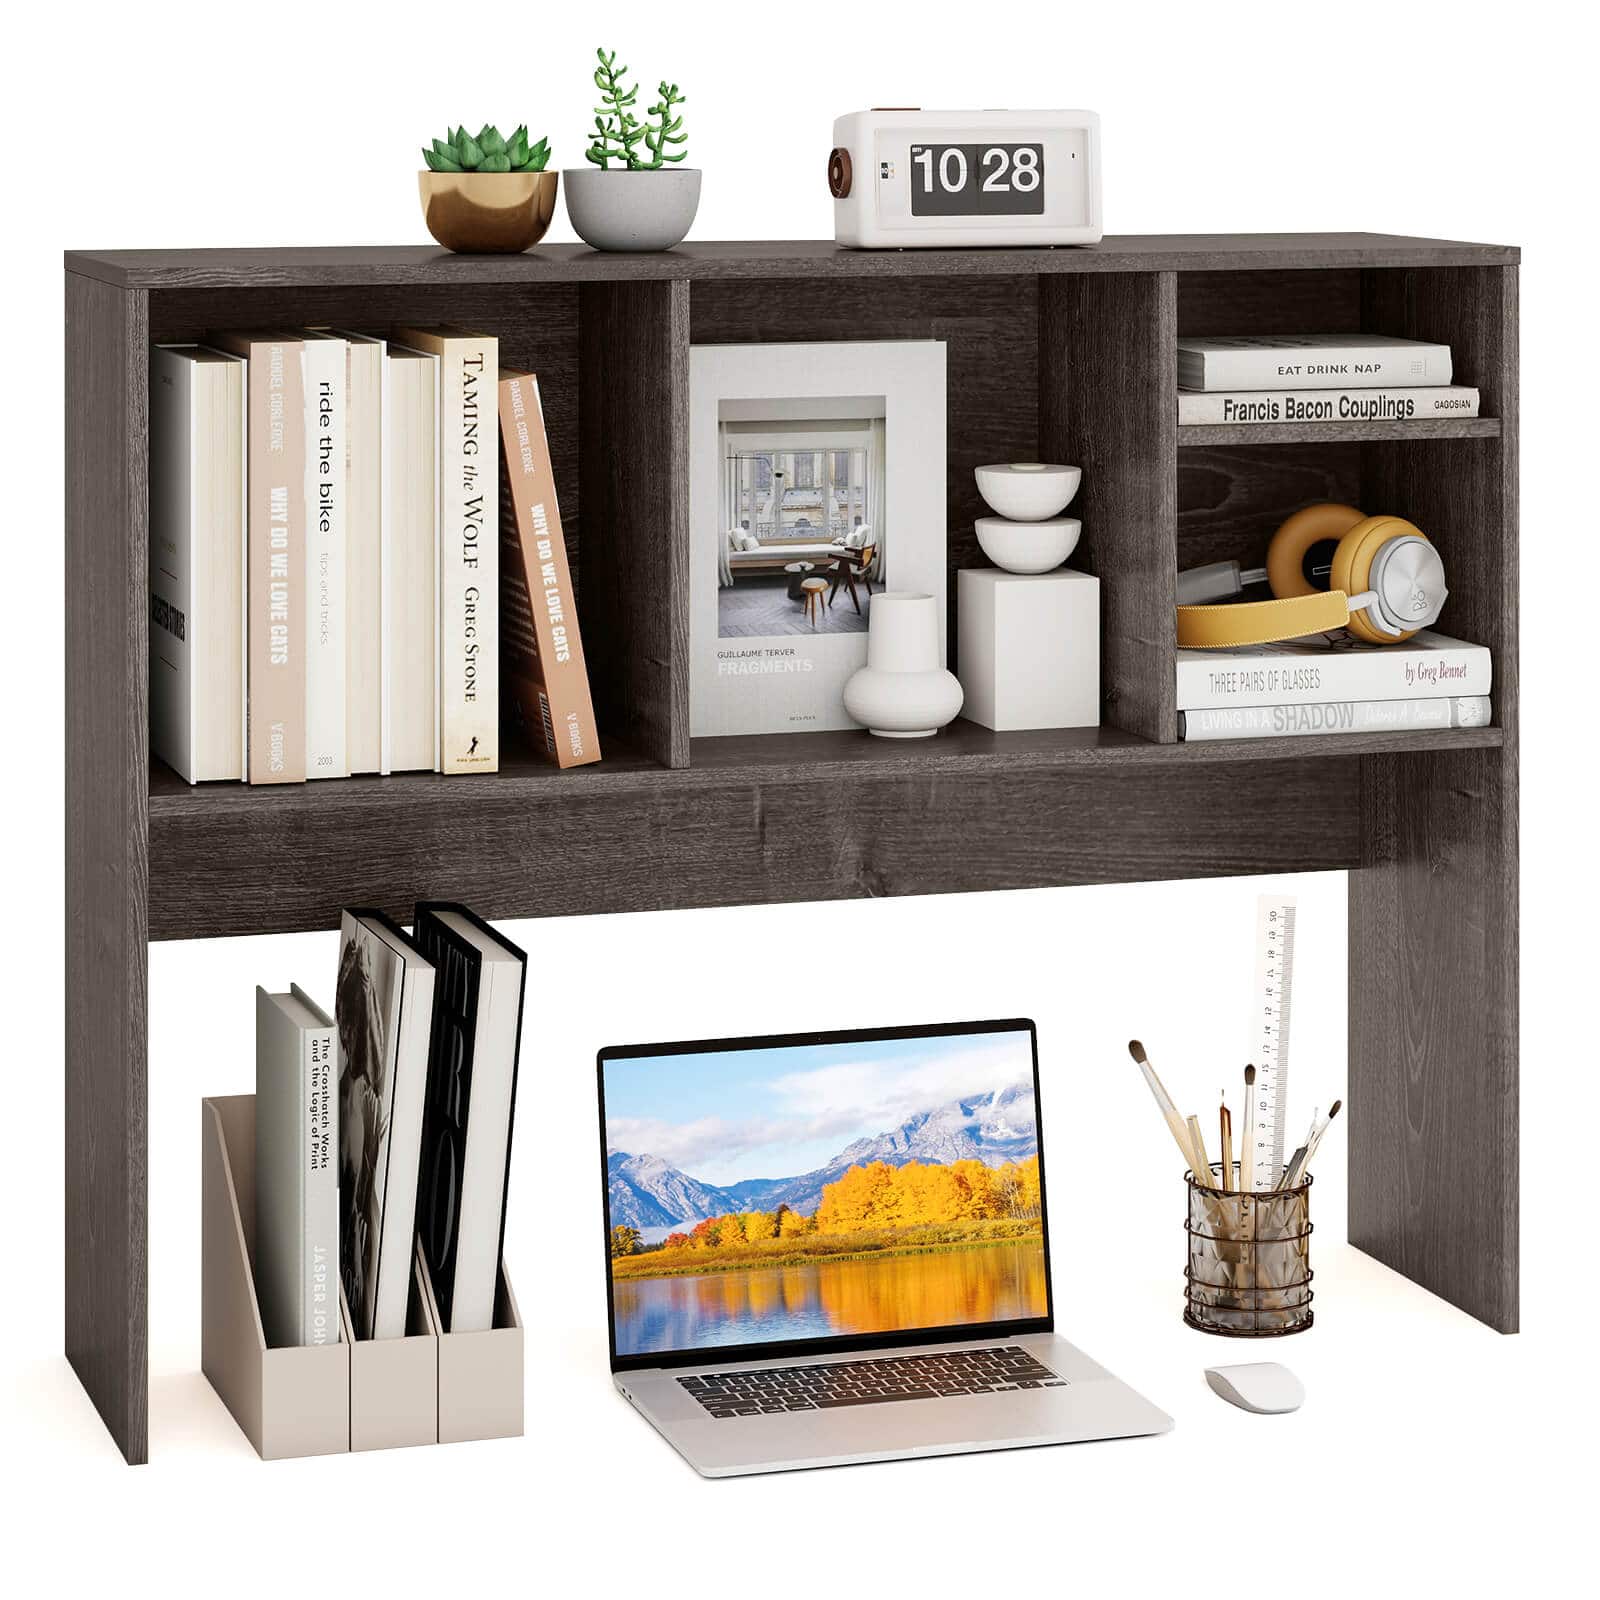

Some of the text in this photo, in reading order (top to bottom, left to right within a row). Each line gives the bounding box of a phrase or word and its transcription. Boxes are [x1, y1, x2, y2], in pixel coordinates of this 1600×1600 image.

[914, 147, 1041, 193] 10 28
[1278, 363, 1382, 375] EAT DRINK NAP
[1223, 395, 1414, 421] Francis Bacon Couplings
[1434, 399, 1471, 410] GAGOSIAN
[319, 382, 333, 533] ride the bike
[463, 352, 484, 569] TAMING the WOLF
[271, 486, 288, 665] WHY DO WE LOVE CATS
[530, 503, 570, 663] WHY DO WE LOVE CATS
[319, 610, 329, 645] tricks
[464, 586, 480, 703] GREG STONE
[717, 648, 796, 659] GUILLAUME TERVER
[718, 659, 814, 675] FRAGMENTS
[1209, 668, 1321, 694] THREE PAIRS OF GLASSES
[1405, 660, 1467, 686] by Greg Bennet
[1201, 710, 1242, 731] LIVING
[1245, 710, 1258, 729] IN
[1261, 710, 1272, 729] A
[1273, 703, 1354, 732] SHADOW
[271, 734, 284, 772] BOOKS
[568, 721, 584, 757] BOOKS
[317, 757, 333, 766] 2003
[309, 1039, 320, 1170] and the Logic of Print
[321, 1036, 330, 1169] The Crosshatch Works
[313, 1244, 327, 1303] JASPER
